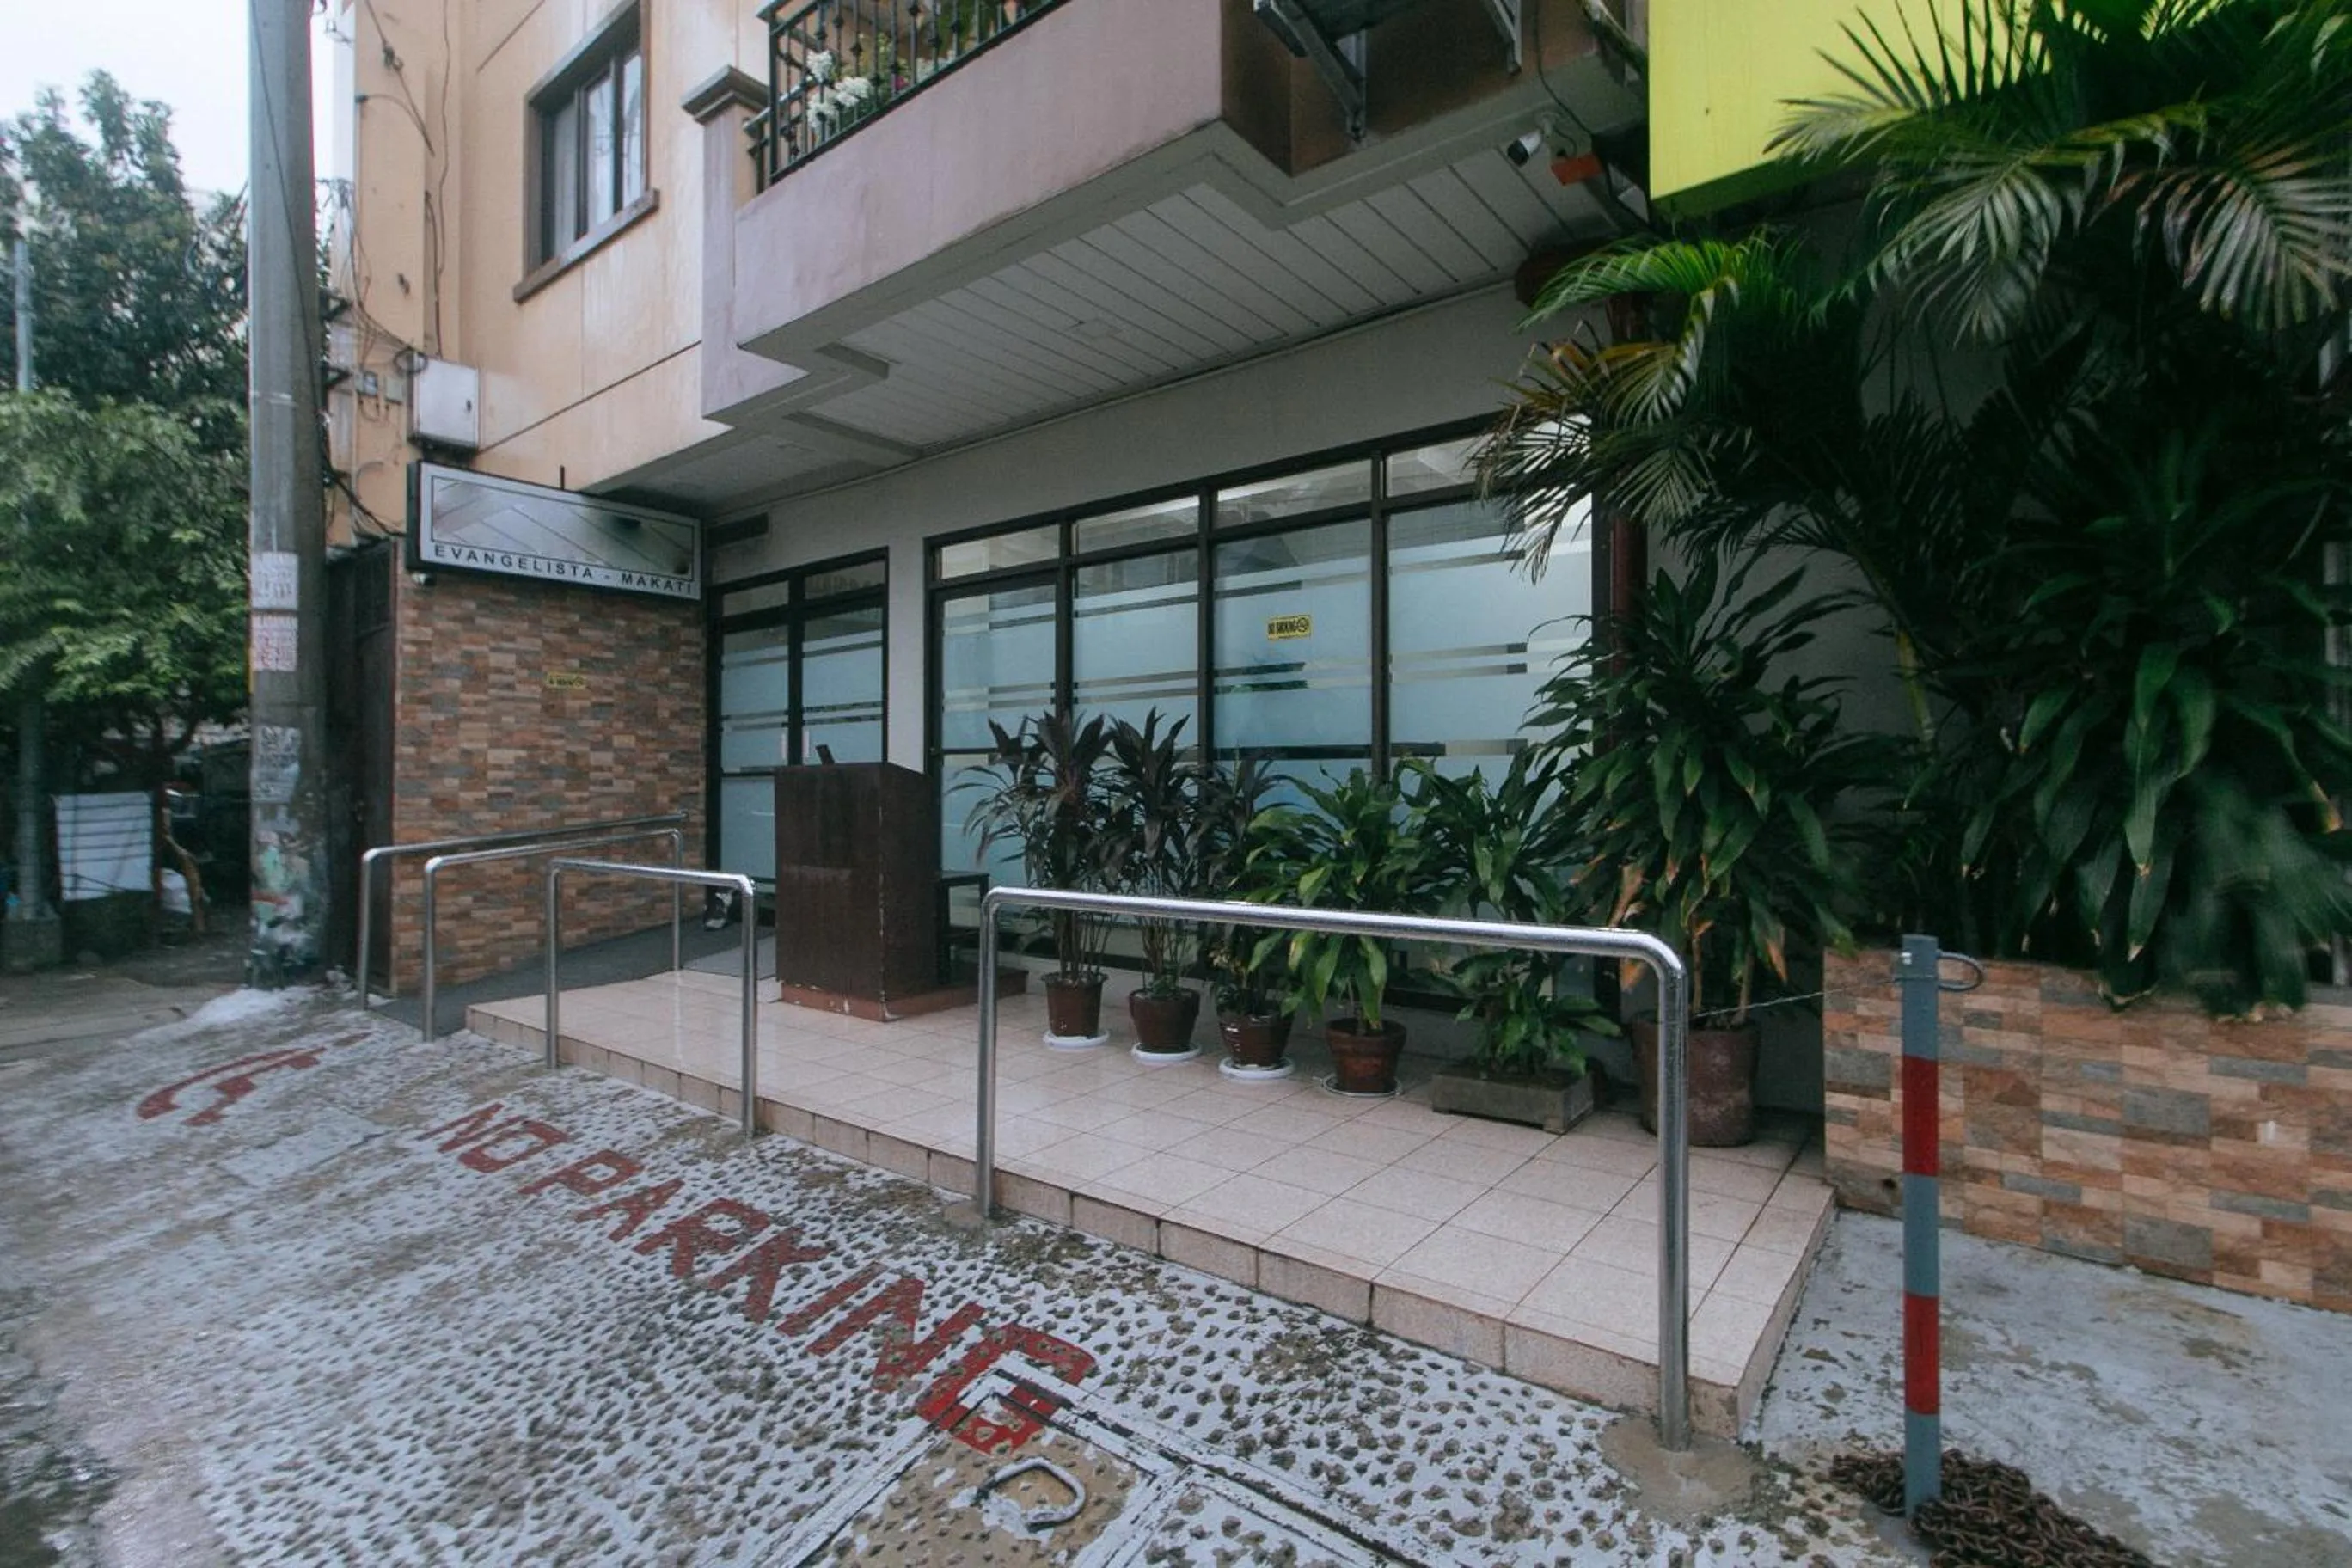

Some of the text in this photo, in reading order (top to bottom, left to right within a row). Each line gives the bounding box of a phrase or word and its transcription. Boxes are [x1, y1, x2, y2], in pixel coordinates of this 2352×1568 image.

[434, 545, 593, 579] EVANGELISTA
[622, 573, 692, 595] MAKATI
[416, 1103, 1096, 1456] NO PARKING
